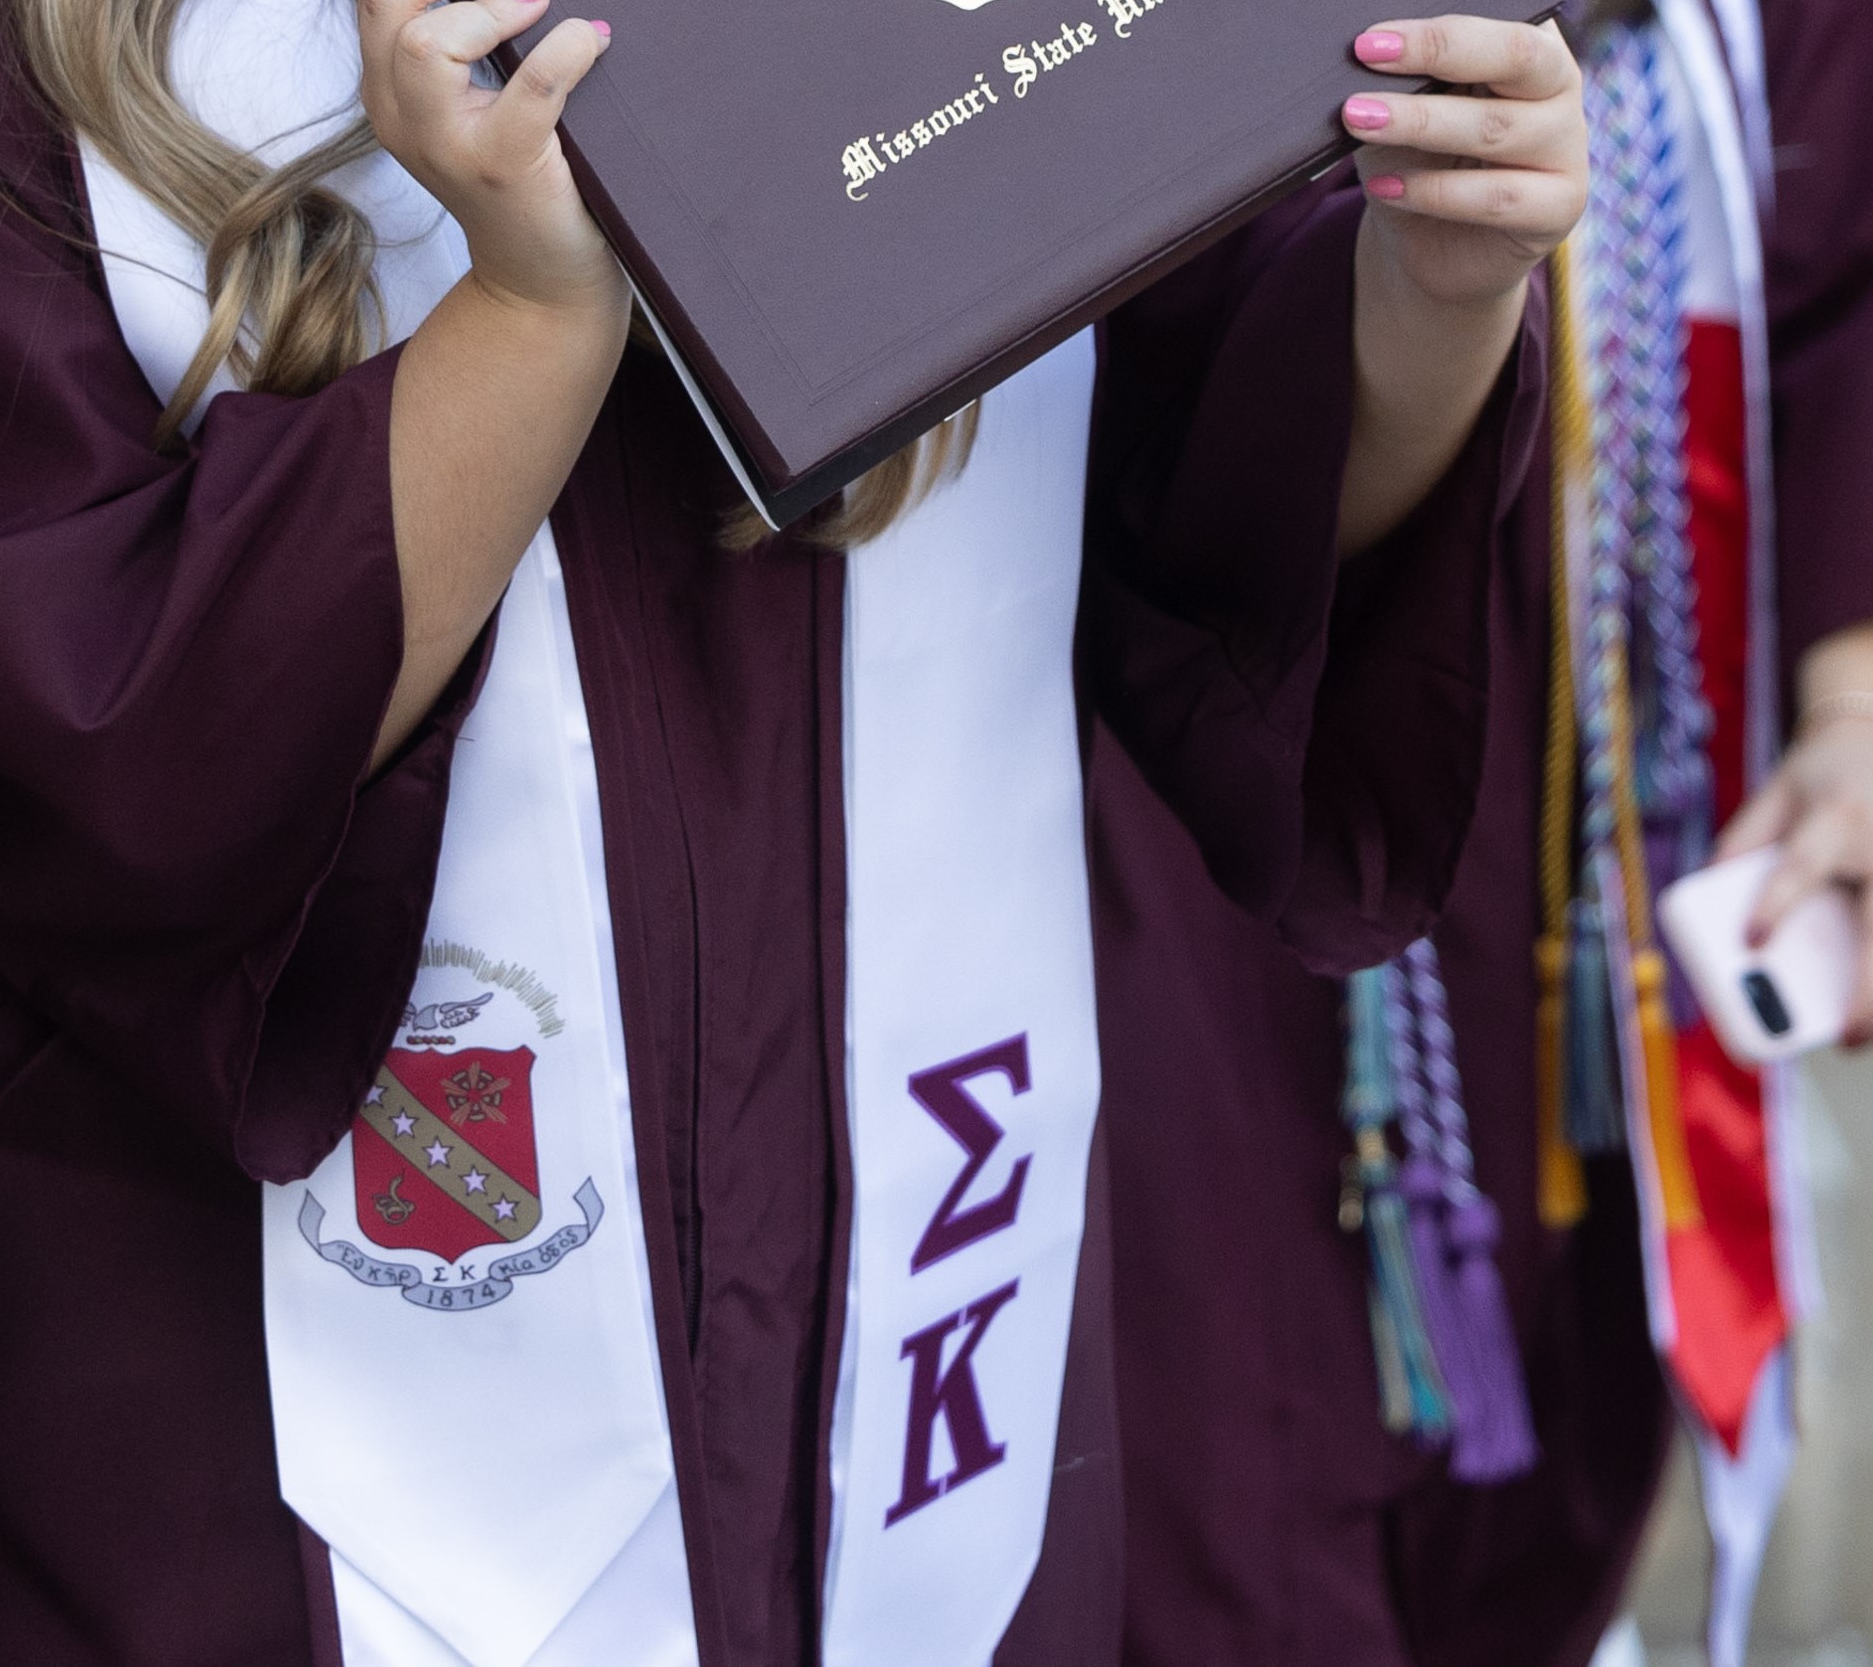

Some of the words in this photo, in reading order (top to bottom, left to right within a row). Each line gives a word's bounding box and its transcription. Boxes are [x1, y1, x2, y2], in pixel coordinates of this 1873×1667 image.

[840, 73, 999, 202] Missouri
[1002, 22, 1098, 99] State
[427, 1284, 495, 1307] 1874
